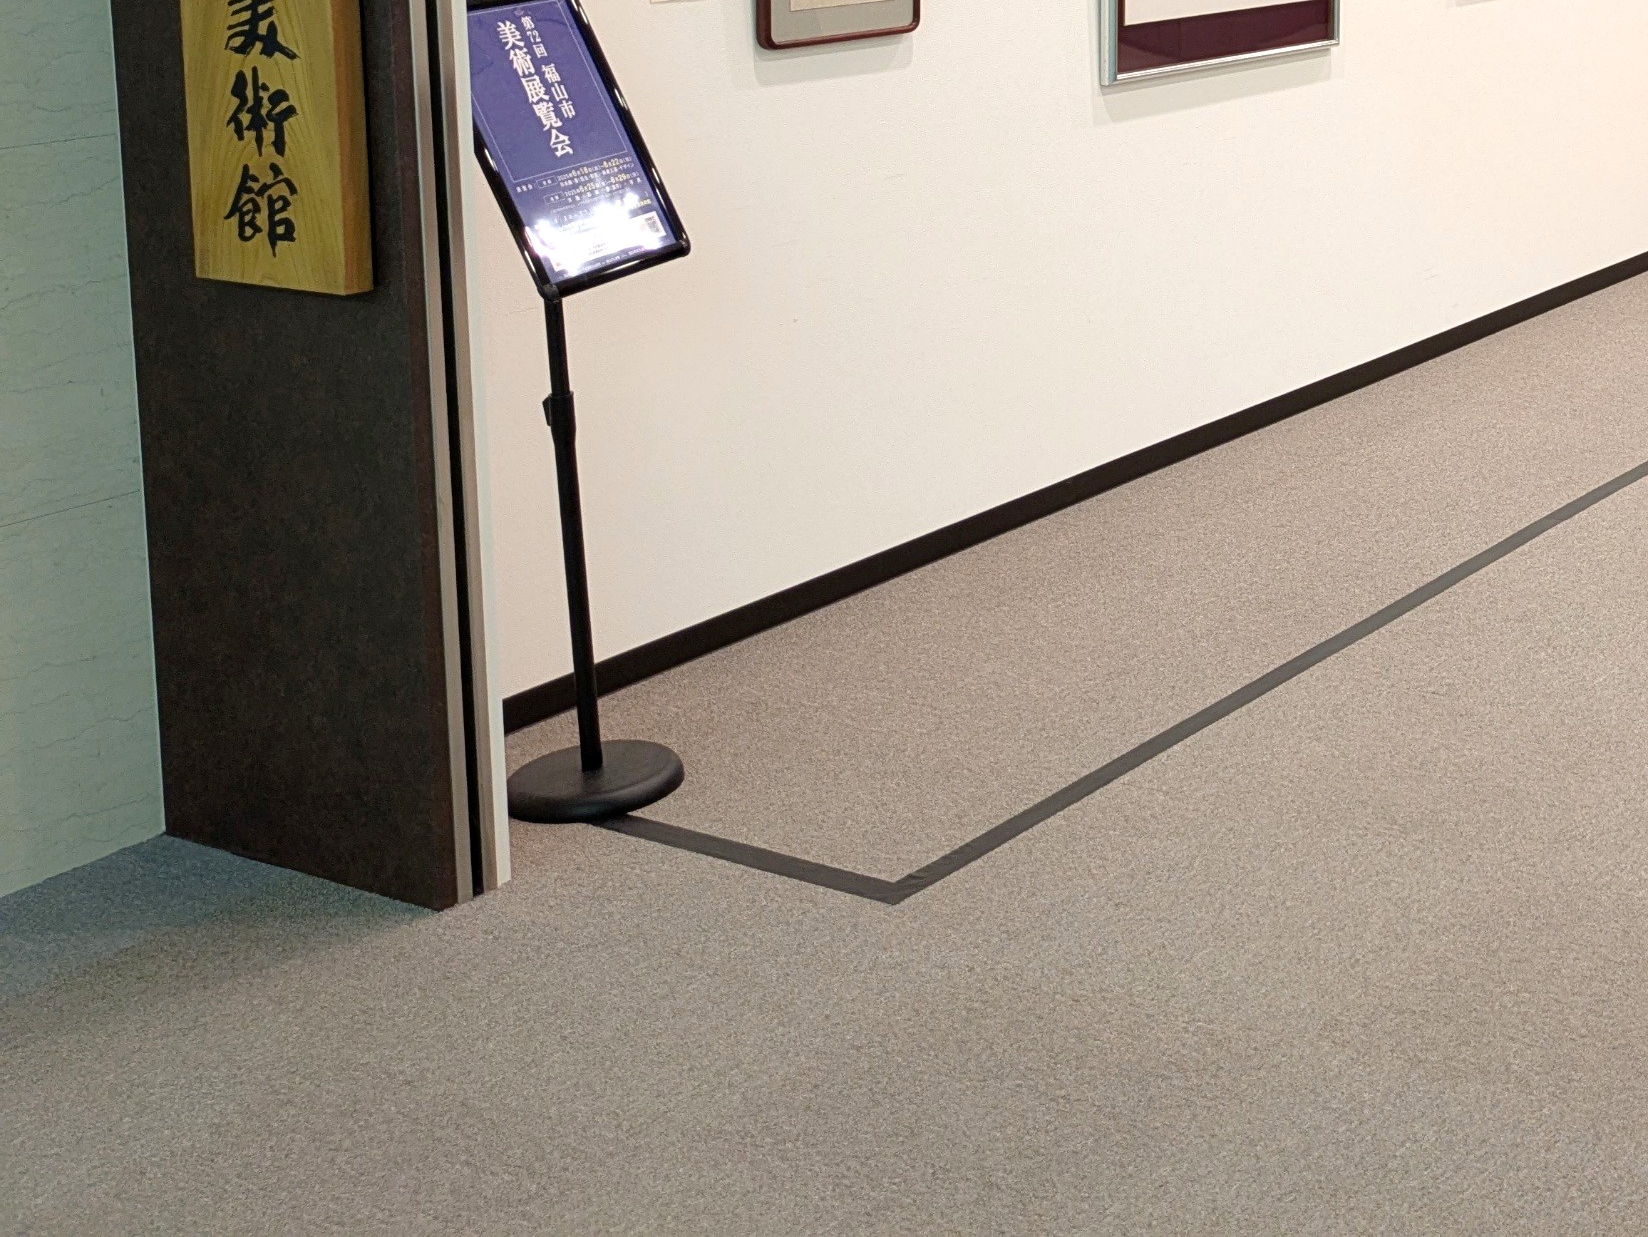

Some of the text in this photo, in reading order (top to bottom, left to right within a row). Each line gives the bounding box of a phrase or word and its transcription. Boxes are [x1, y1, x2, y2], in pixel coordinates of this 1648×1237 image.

[496, 20, 574, 158] 美術展覧会
[520, 15, 576, 120] 第72回 福山市
